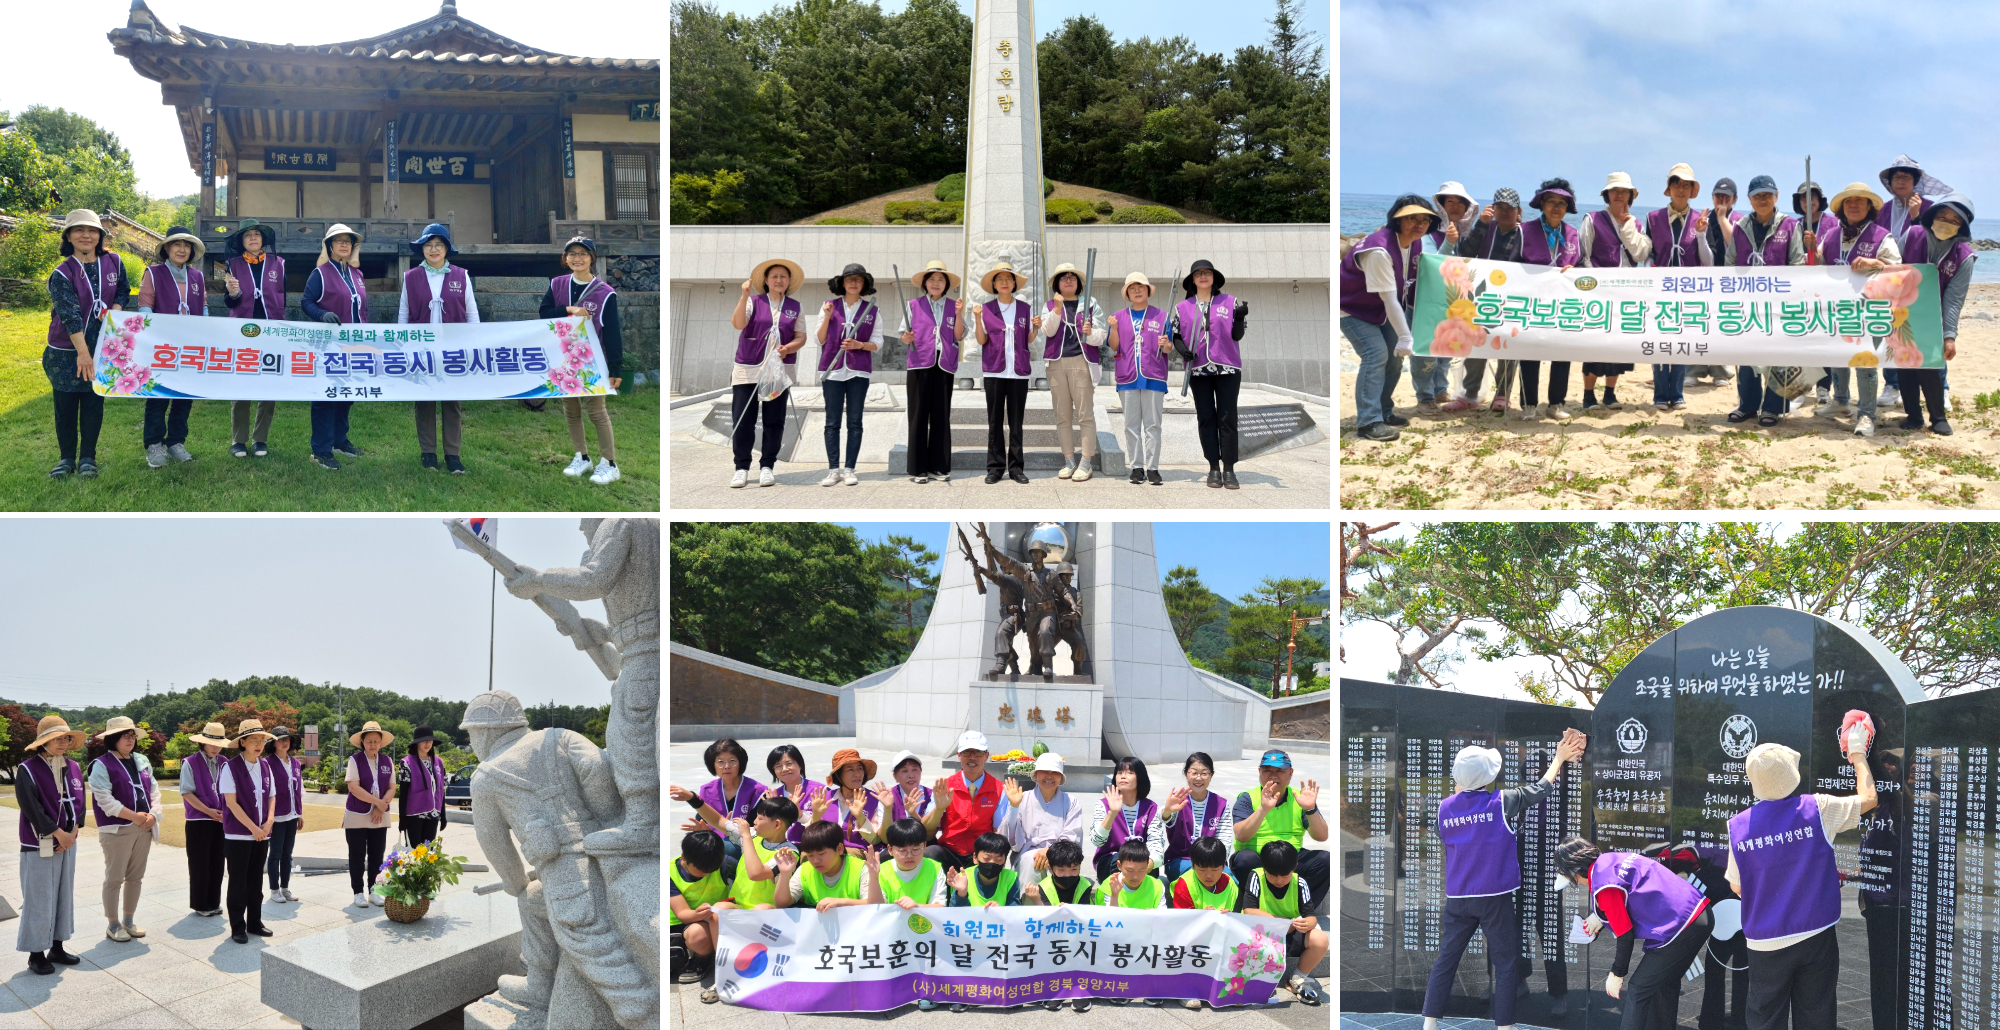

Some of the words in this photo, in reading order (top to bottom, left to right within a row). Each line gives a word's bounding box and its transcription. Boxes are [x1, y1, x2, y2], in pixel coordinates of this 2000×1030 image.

[996, 39, 1014, 112] 충혼탑
[1661, 276, 1714, 294] 회원과
[1719, 276, 1792, 294] 함께하는
[1472, 293, 1612, 331] 호국보훈의
[1619, 299, 1647, 334] 달
[1654, 300, 1711, 334] 전국
[1716, 300, 1773, 335] 동시
[1779, 299, 1896, 335] 봉사활동
[262, 326, 332, 339] 세계평화여성연합
[338, 329, 377, 342] 회원과
[383, 329, 436, 343] 함께하는
[1641, 341, 1709, 357] 영덕지부
[151, 344, 281, 373] 호국보훈의
[291, 350, 315, 375] 달
[323, 351, 374, 375] 전국
[382, 350, 434, 374] 동시
[442, 347, 547, 374] 봉사활동
[325, 386, 383, 399] 성주지부
[1711, 648, 1741, 670] 나는
[1744, 645, 1770, 669] 오늘
[1635, 675, 1673, 699] 조국을
[1677, 678, 1718, 696] 위하여
[1720, 673, 1760, 697] 무엇을
[1762, 671, 1812, 695] 하였는
[1617, 759, 1646, 769] 대한민국
[1722, 762, 1747, 773] 대한민
[1602, 770, 1637, 780] 상이군경회
[1639, 770, 1661, 780] 유공자
[1707, 774, 1740, 785] 특수임무
[1816, 778, 1857, 789] 고엽제전우
[1875, 780, 1894, 792] 공자
[1596, 787, 1630, 802] 우국충정
[1632, 789, 1666, 804] 조국수호
[1704, 791, 1738, 806] 음지에서
[1442, 812, 1494, 829] 세계평화여성연합
[1701, 807, 1738, 820] 양지에서
[1736, 825, 1814, 852] 세계평화여성연합
[943, 920, 1005, 939] 회원과
[814, 940, 936, 974] 호국보훈의
[950, 943, 975, 968] 달
[986, 944, 1037, 971] 전국
[1047, 939, 1097, 966] 동시
[1109, 943, 1212, 969] 봉사활동
[912, 979, 1045, 999] (사)세계평화여성연합
[1048, 980, 1073, 991] 경북
[1077, 977, 1130, 992] 영양지부
